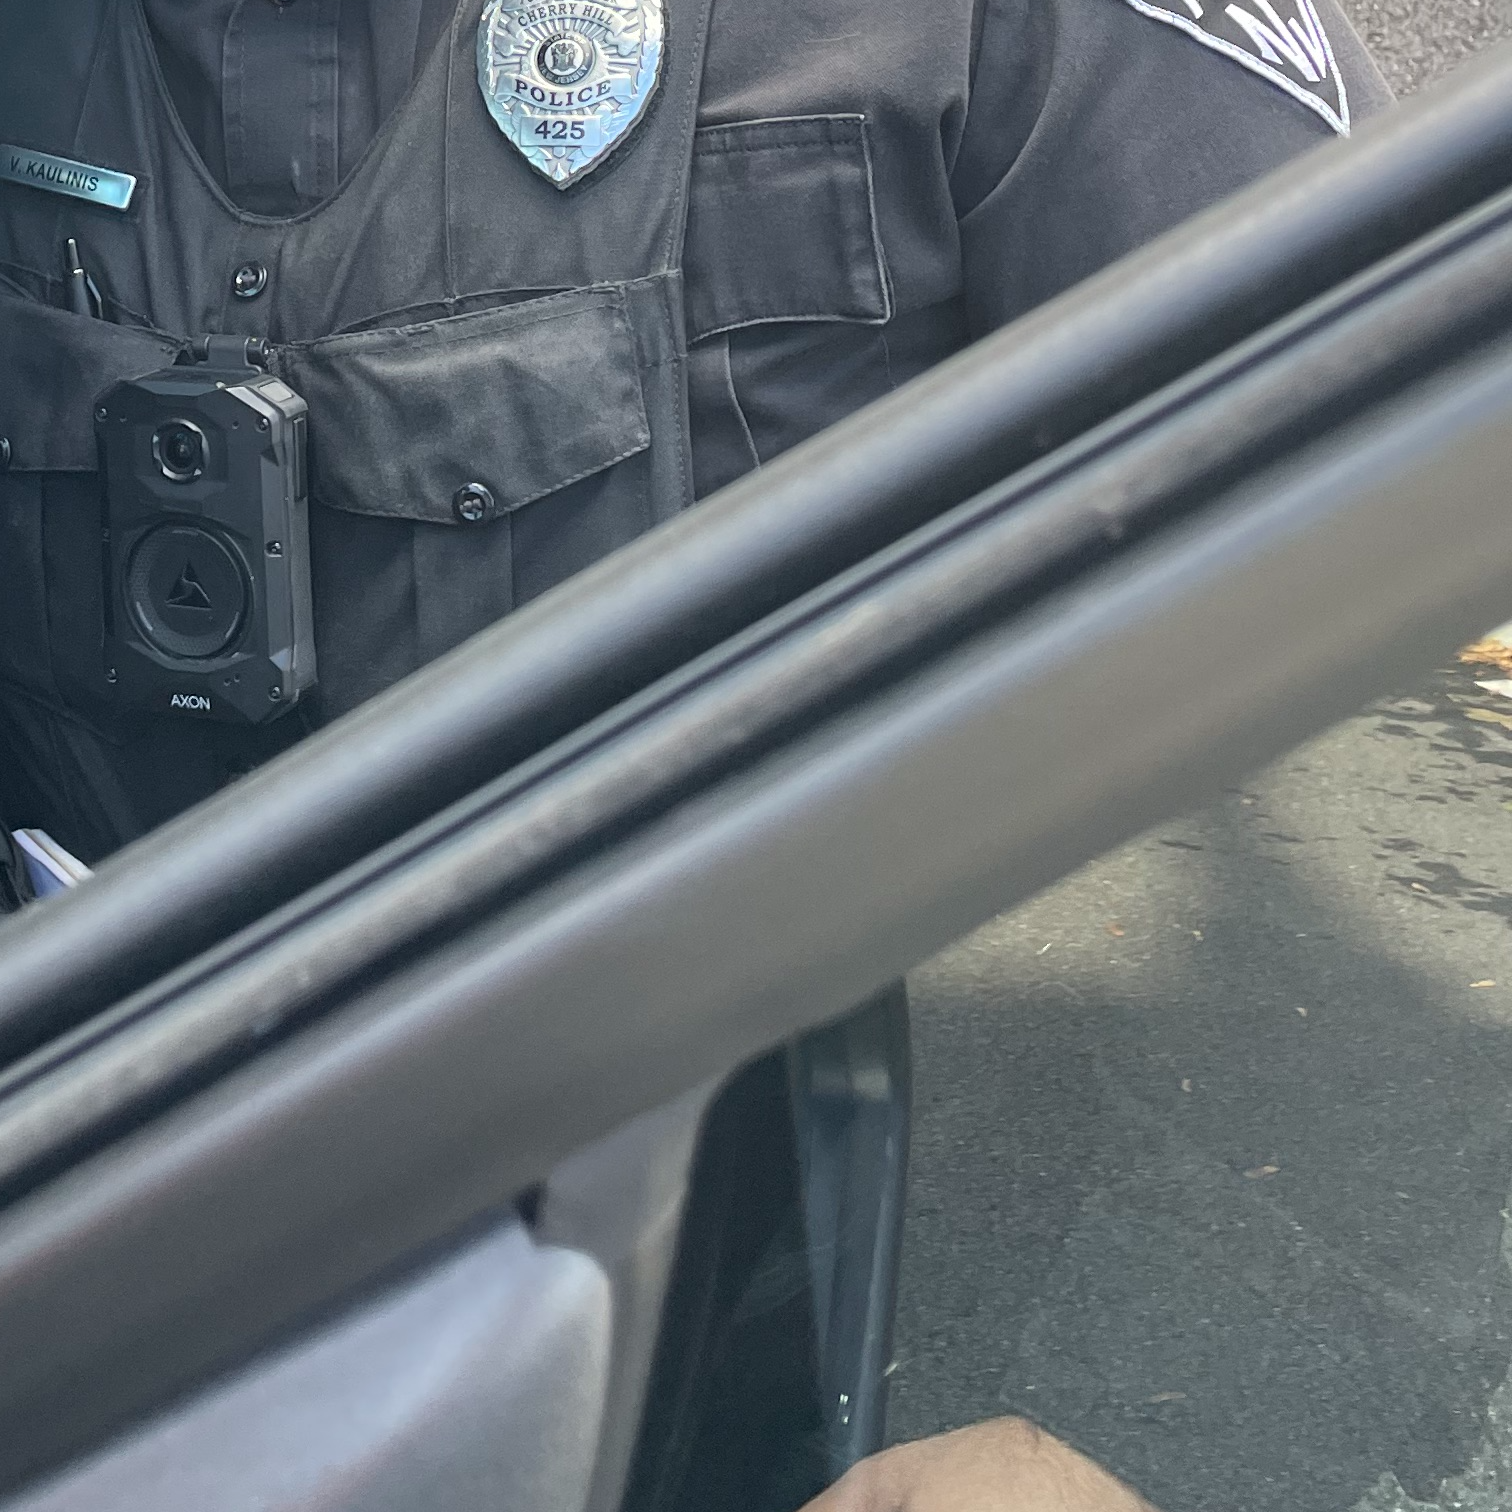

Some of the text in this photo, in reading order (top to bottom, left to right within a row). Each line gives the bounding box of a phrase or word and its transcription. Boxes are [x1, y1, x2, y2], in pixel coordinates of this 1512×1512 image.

[518, 3, 613, 27] CHERRY HILL
[515, 79, 611, 106] POLICE
[534, 120, 585, 139] 425
[10, 156, 99, 192] V. KAULINIS
[170, 694, 211, 710] AXON
